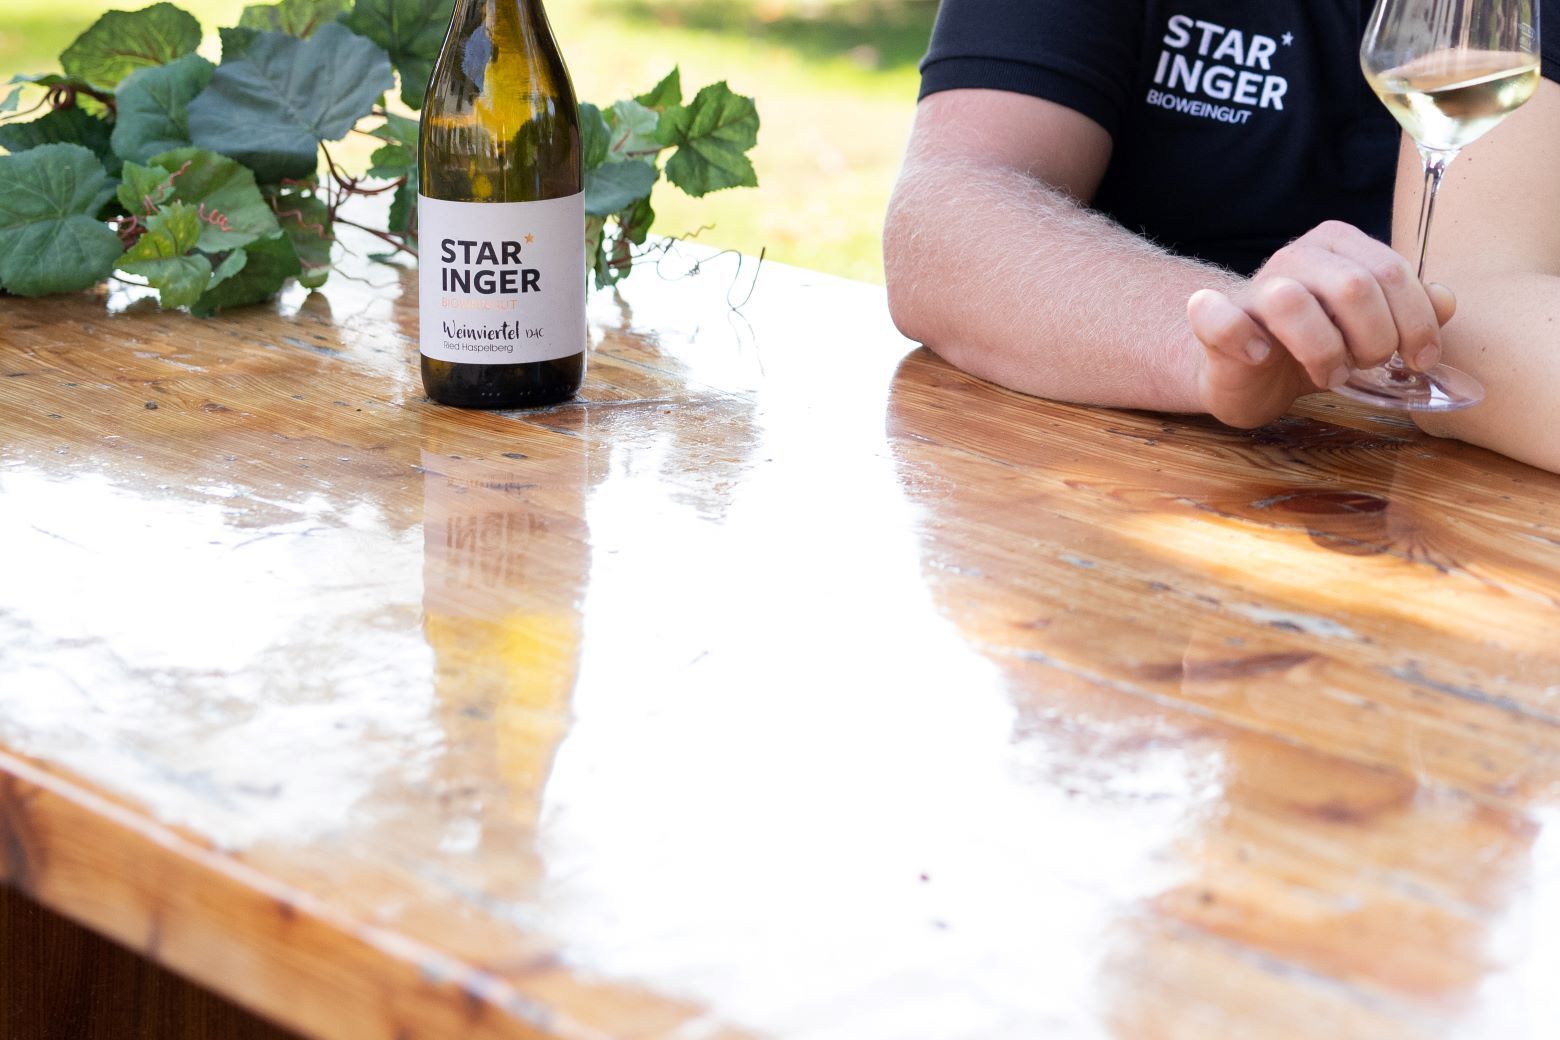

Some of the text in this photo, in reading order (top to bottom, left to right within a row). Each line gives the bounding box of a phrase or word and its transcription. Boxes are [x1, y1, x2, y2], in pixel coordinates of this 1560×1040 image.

[1163, 14, 1277, 70] STAR
[1153, 50, 1288, 110] INGER
[1146, 89, 1252, 125] BIOWEINGUT
[441, 238, 523, 265] STAR
[442, 267, 541, 294] INGER
[443, 319, 545, 340] Weinviertel DAC
[443, 341, 514, 354] Ried Haspelberg
